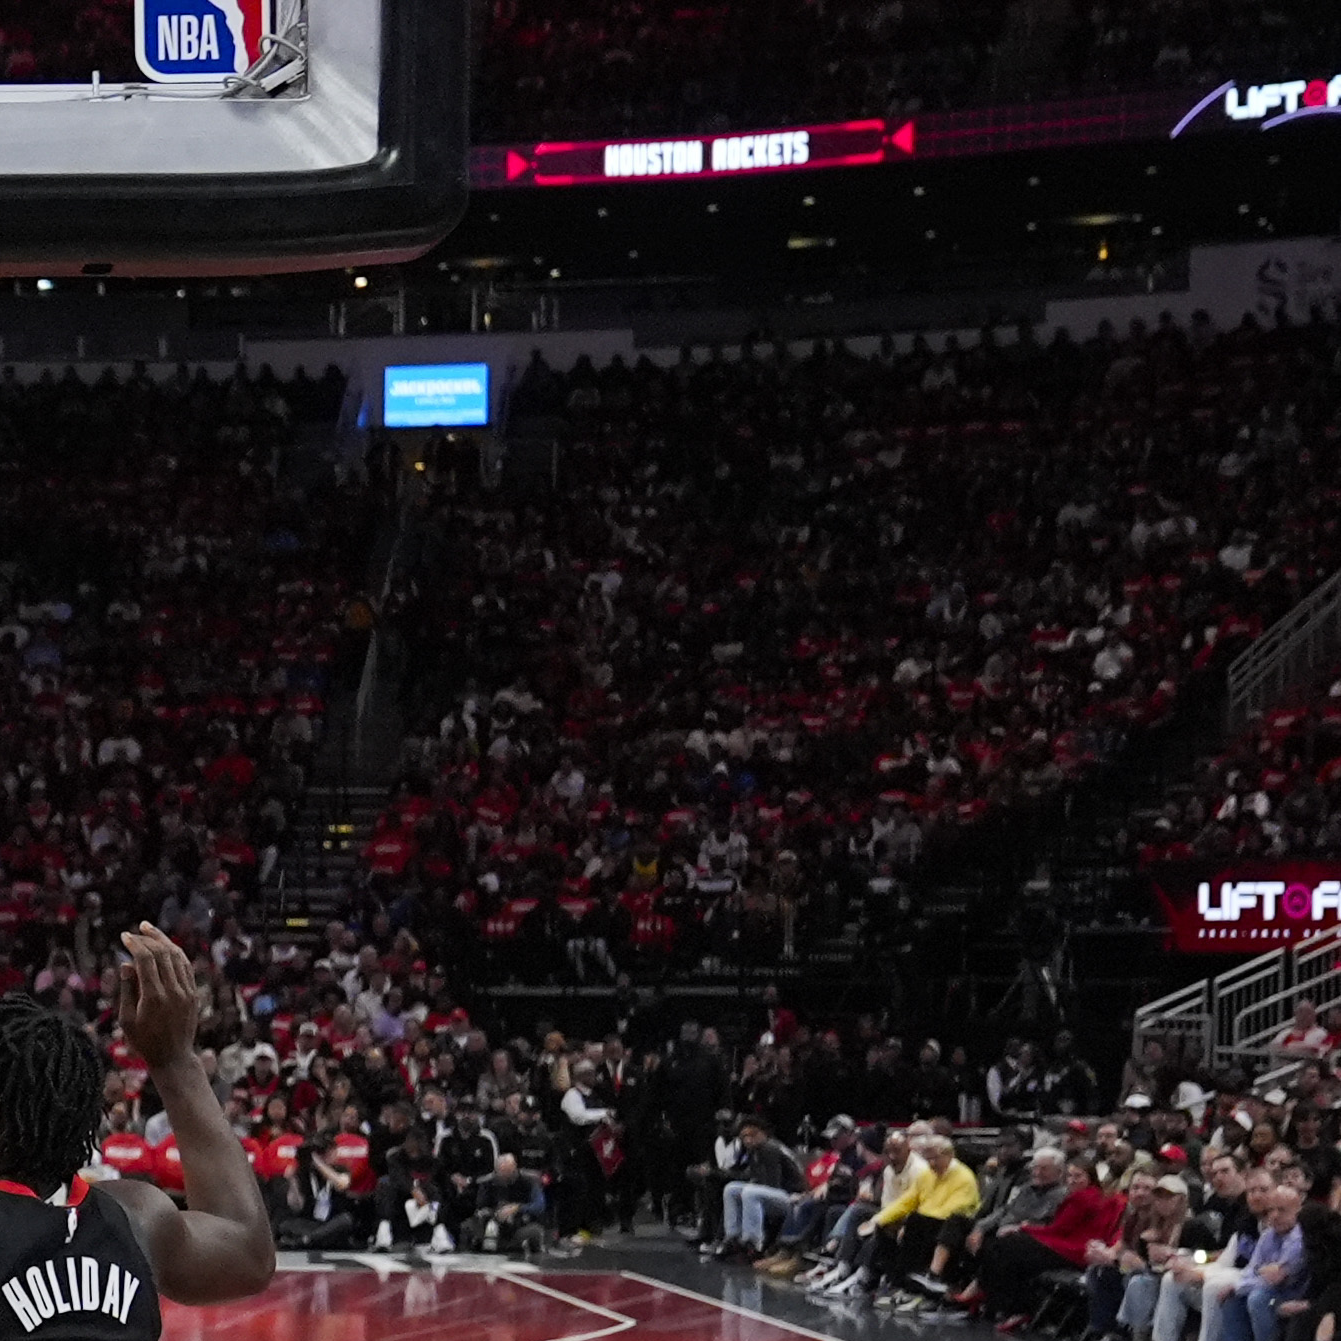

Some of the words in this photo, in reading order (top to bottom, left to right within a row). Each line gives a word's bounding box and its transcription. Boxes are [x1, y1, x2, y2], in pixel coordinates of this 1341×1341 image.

[157, 14, 220, 61] NBA
[604, 139, 704, 178] HOUSTON
[712, 130, 810, 172] ROCKETS
[1, 1256, 140, 1333] HOLIDAY
